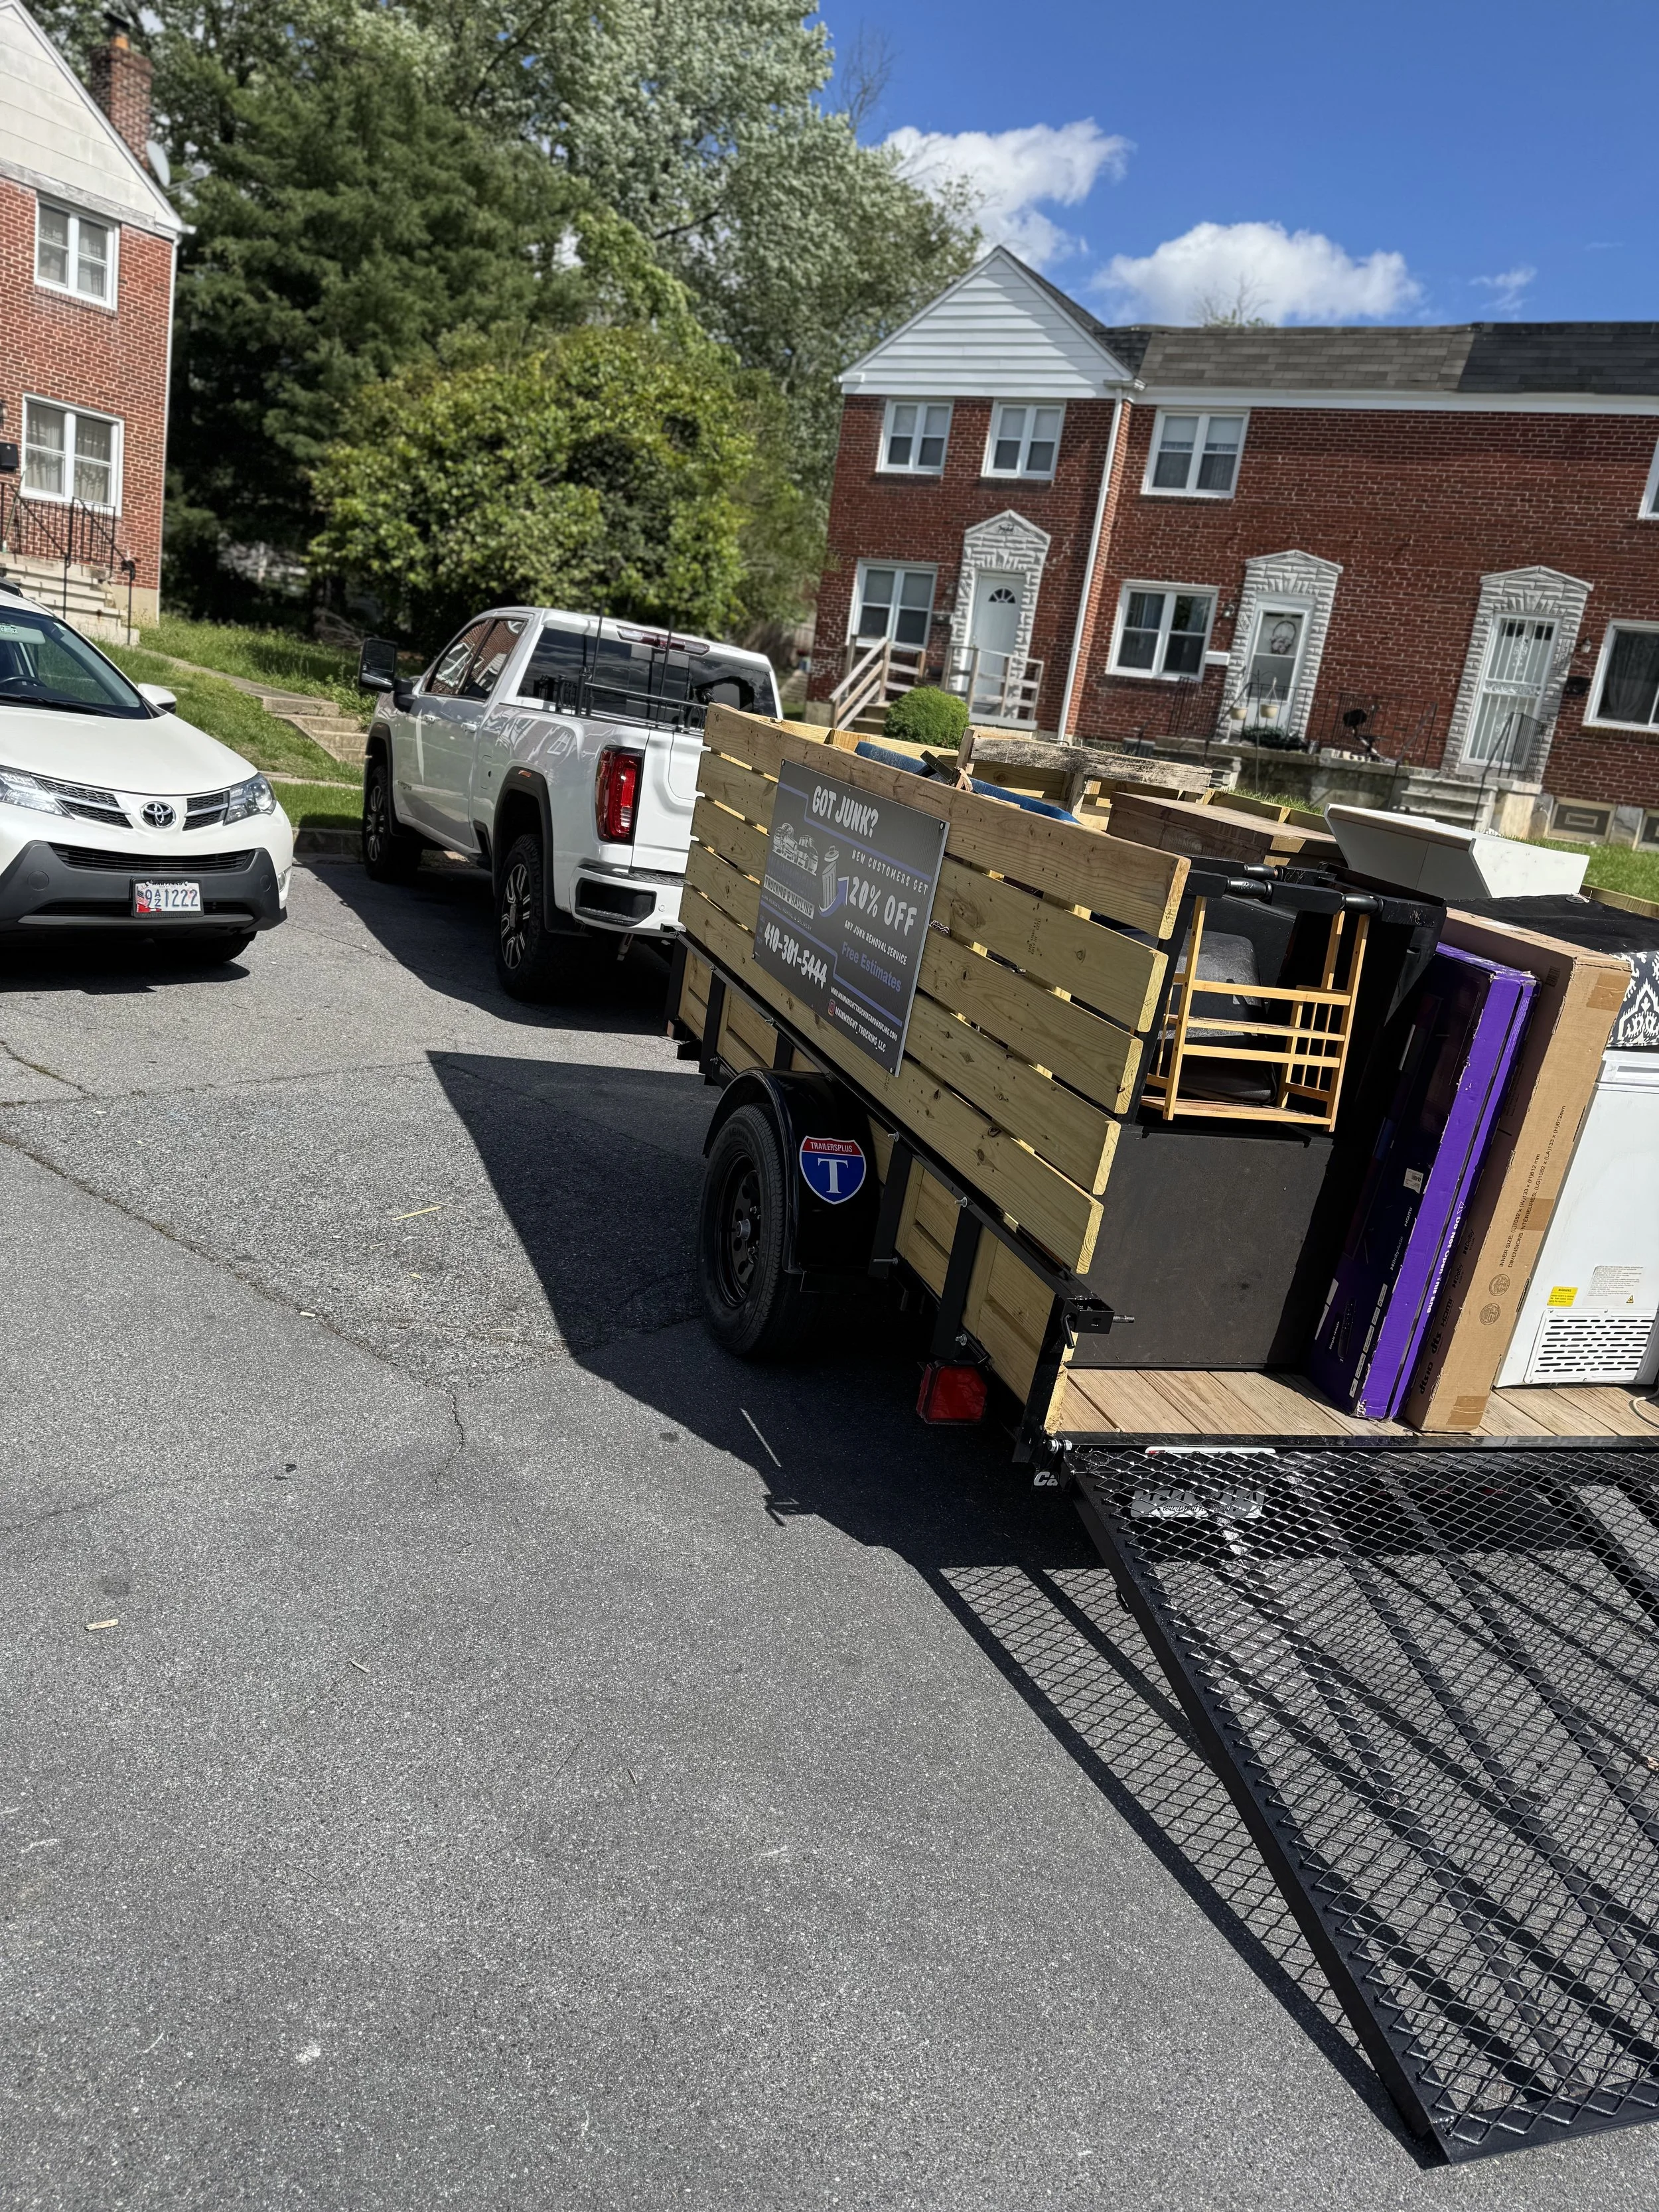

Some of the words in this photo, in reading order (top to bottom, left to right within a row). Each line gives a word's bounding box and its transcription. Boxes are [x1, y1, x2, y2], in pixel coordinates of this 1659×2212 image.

[812, 785, 836, 820] GOT
[835, 795, 879, 838] JUNK?
[851, 849, 865, 864] NEW
[868, 857, 910, 887] CUSTOMERS
[913, 879, 928, 895] GET
[765, 877, 786, 899] TRUCKING
[791, 894, 812, 916] HAULING
[849, 876, 881, 917] 20%
[884, 895, 917, 936] OFF
[764, 922, 827, 989] 410-301-5444
[844, 920, 853, 931] ANY
[853, 925, 865, 940] JUNK
[865, 933, 887, 953] REMOVAL
[887, 946, 907, 966] SERVICE
[841, 942, 859, 964] Free
[860, 954, 902, 992] Estimates
[810, 1142, 853, 1153] TRAILERSPLUS
[818, 1157, 849, 1194] T
[1508, 1232, 1524, 1268] DIMENSIONS
[1534, 1165, 1546, 1191] (LG)1052
[1544, 1139, 1555, 1160] (LA)133
[1553, 1106, 1566, 1134] (H)612mm
[1453, 1217, 1461, 1229] Do
[1498, 1249, 1508, 1268] INNER
[1505, 1234, 1514, 1248] SIZE:
[1510, 1213, 1521, 1233] (L)1052
[1520, 1189, 1529, 1208] (W)133
[1528, 1165, 1537, 1183] (H)612
[1534, 1153, 1540, 1164] mm
[1447, 1232, 1456, 1248] Not
[1465, 1229, 1475, 1246] Dolby
[1439, 1250, 1450, 1274] Open
[1454, 1264, 1463, 1280] Dolby
[1441, 1298, 1453, 1327] HDMI
[1430, 1332, 1442, 1355] dts
[1419, 1374, 1429, 1394] dts
